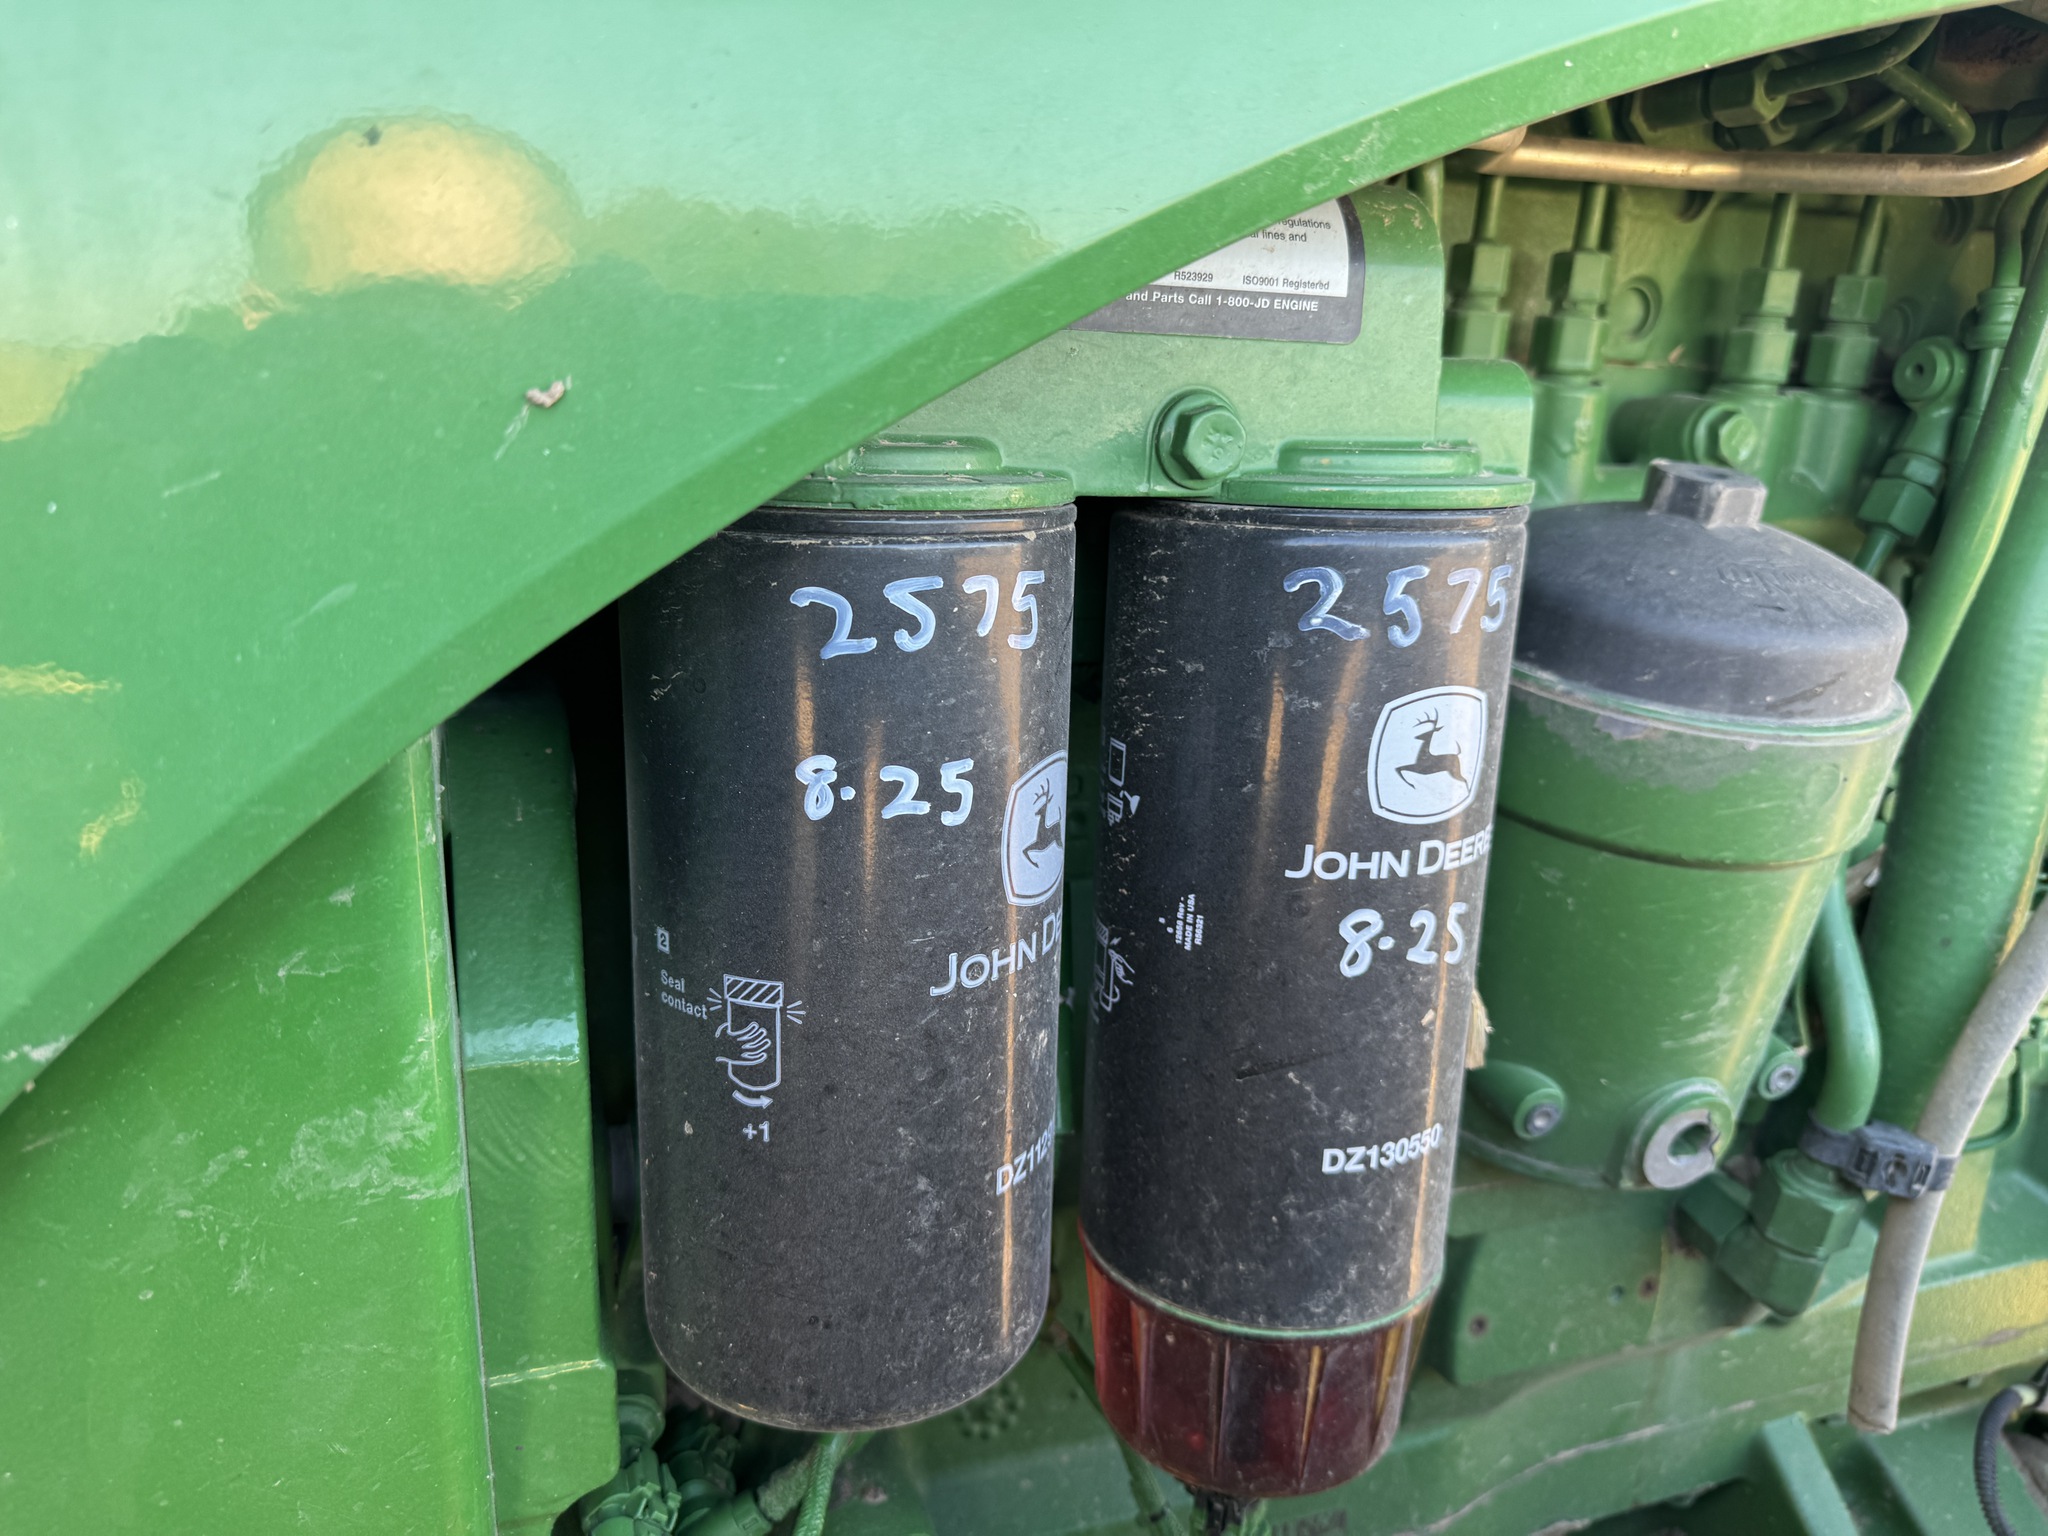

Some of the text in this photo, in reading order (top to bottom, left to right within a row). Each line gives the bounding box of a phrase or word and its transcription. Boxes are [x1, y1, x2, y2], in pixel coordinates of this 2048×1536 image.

[1262, 230, 1286, 240] lines
[1288, 232, 1307, 242] and
[1174, 270, 1214, 282] R523929
[1242, 275, 1330, 290] ISO9001 Registered
[1125, 290, 1319, 312] and Parts Call 1-800-JD ENGINE
[1284, 823, 1493, 881] JOHN DEERE
[1184, 894, 1196, 951] MADE IN USA
[929, 931, 1038, 997] JOHN
[660, 969, 686, 993] Seal
[661, 991, 709, 1020] contact
[743, 1121, 770, 1142] +1
[1321, 1122, 1443, 1175] DZ130550
